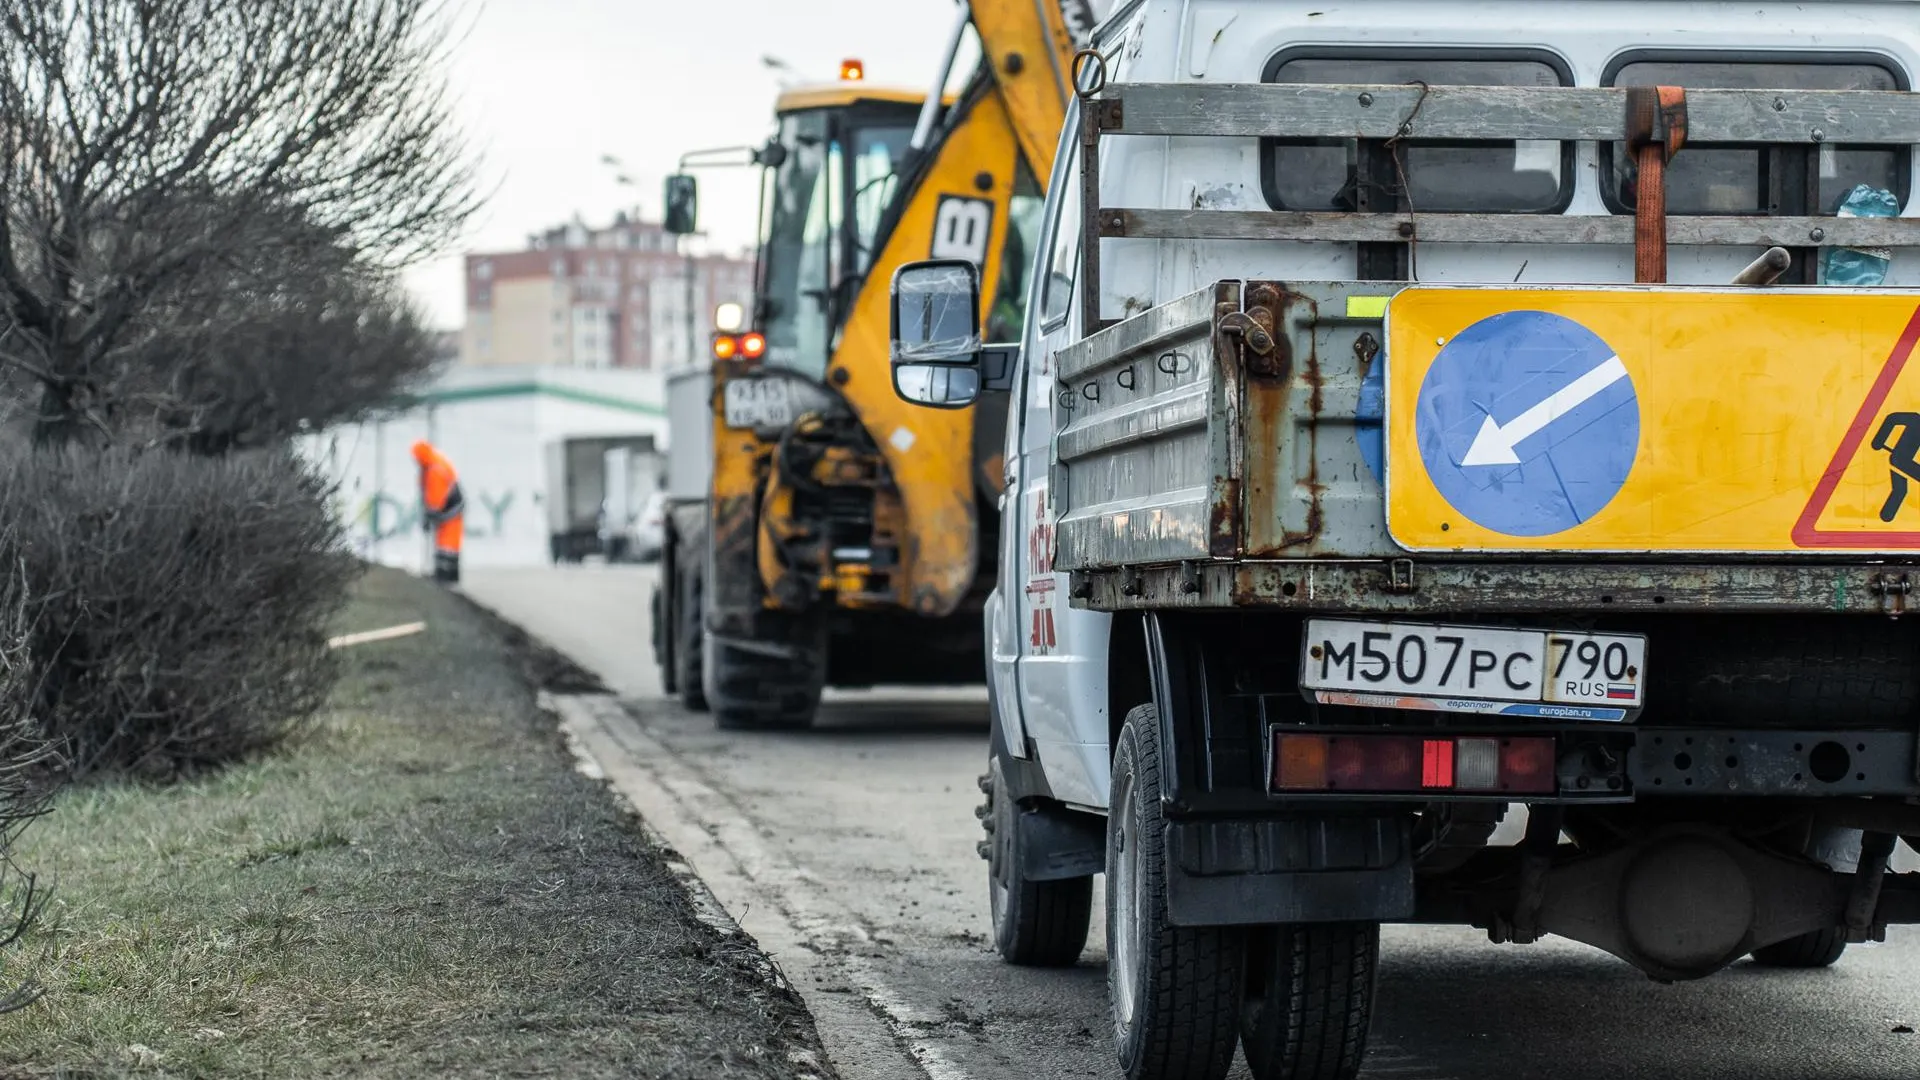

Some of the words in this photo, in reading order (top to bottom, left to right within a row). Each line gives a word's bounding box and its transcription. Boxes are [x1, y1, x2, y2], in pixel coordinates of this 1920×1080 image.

[1320, 631, 1534, 691] М507РС
[1551, 639, 1629, 681] 790
[1565, 681, 1605, 697] RUS
[1447, 699, 1494, 710] европлан
[1539, 706, 1592, 718] europlan.ru
